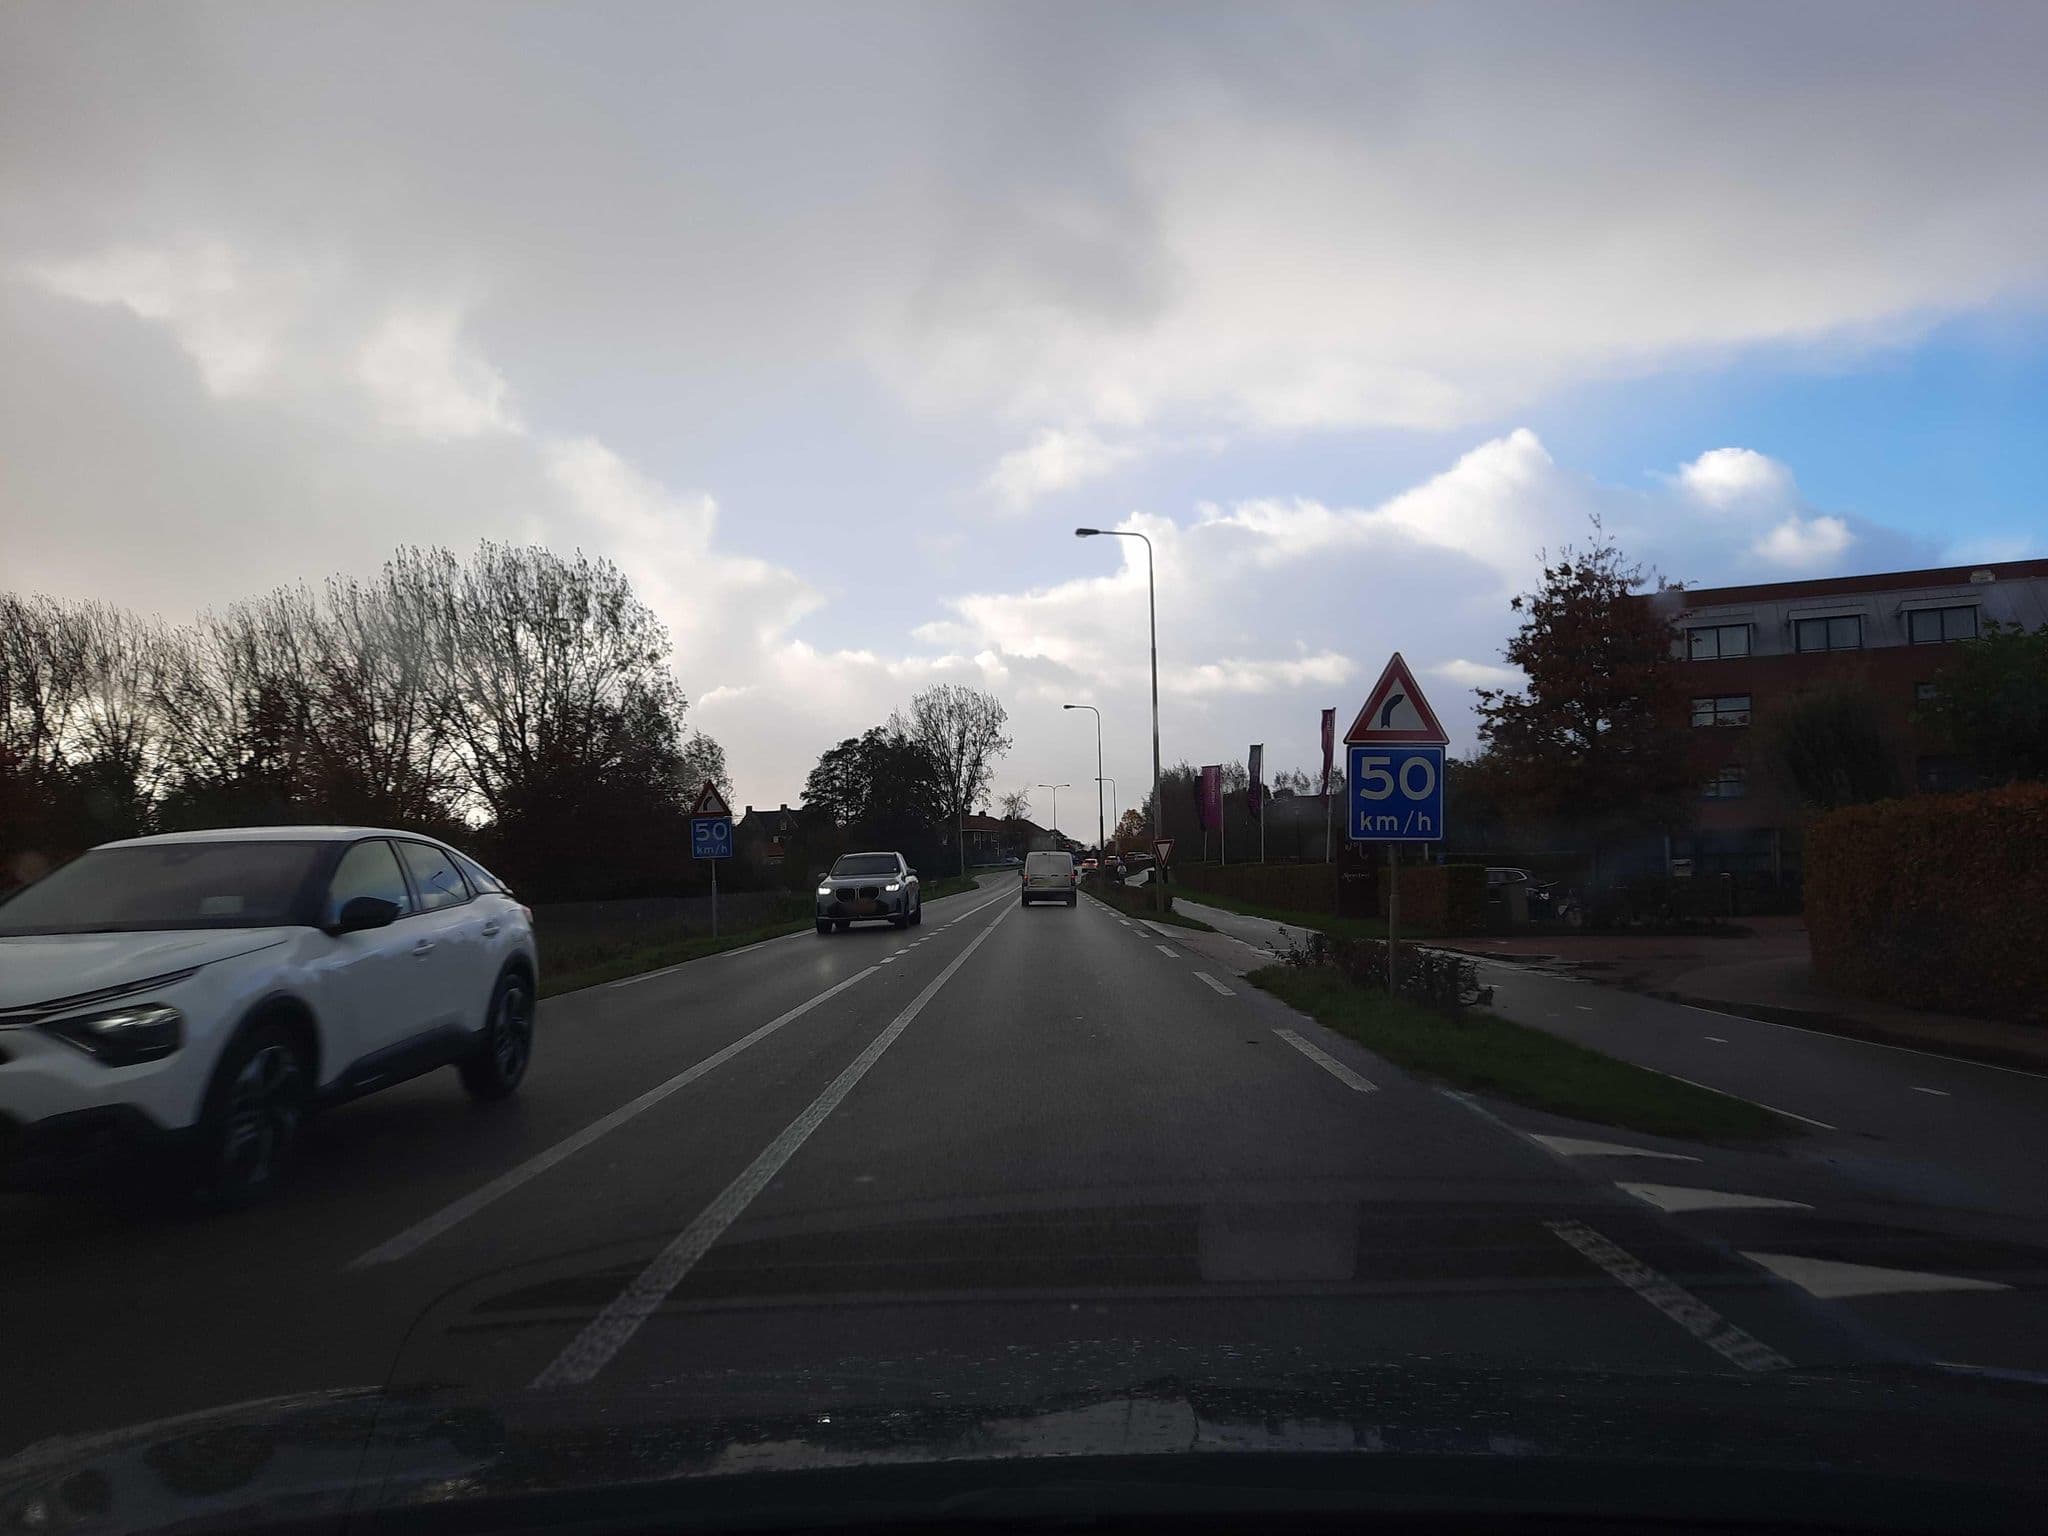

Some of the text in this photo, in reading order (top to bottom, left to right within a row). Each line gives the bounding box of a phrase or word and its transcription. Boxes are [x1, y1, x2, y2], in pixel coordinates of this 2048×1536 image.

[1360, 757, 1436, 800] 50
[696, 822, 727, 841] 50
[1360, 810, 1431, 834] km/h
[697, 845, 727, 855] km/h
